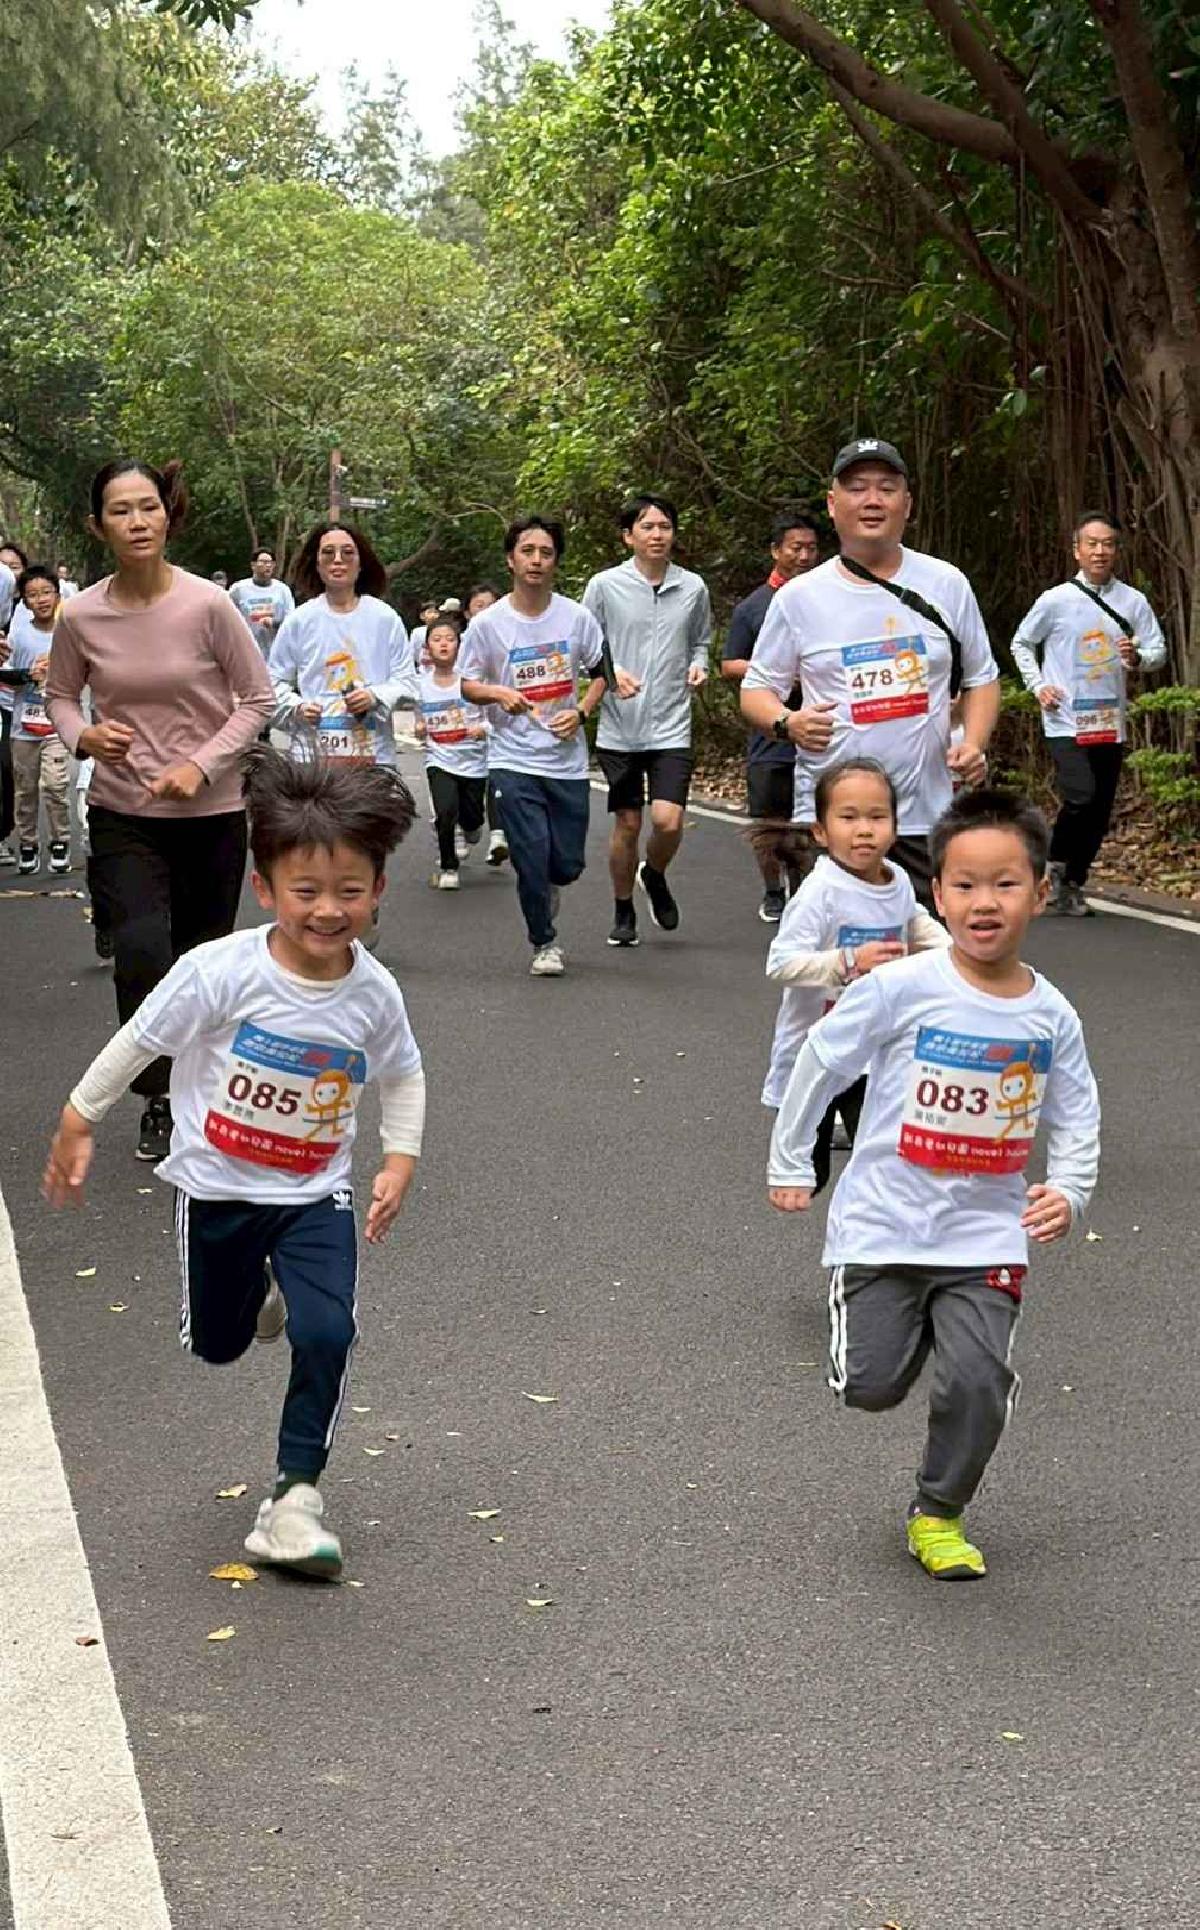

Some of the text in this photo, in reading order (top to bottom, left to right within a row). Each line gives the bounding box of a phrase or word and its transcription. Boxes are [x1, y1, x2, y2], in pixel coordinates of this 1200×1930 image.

[516, 665, 546, 679] 488
[851, 668, 894, 689] 478
[319, 735, 348, 749] 201
[228, 1074, 302, 1115] 085
[916, 1079, 989, 1115] 083
